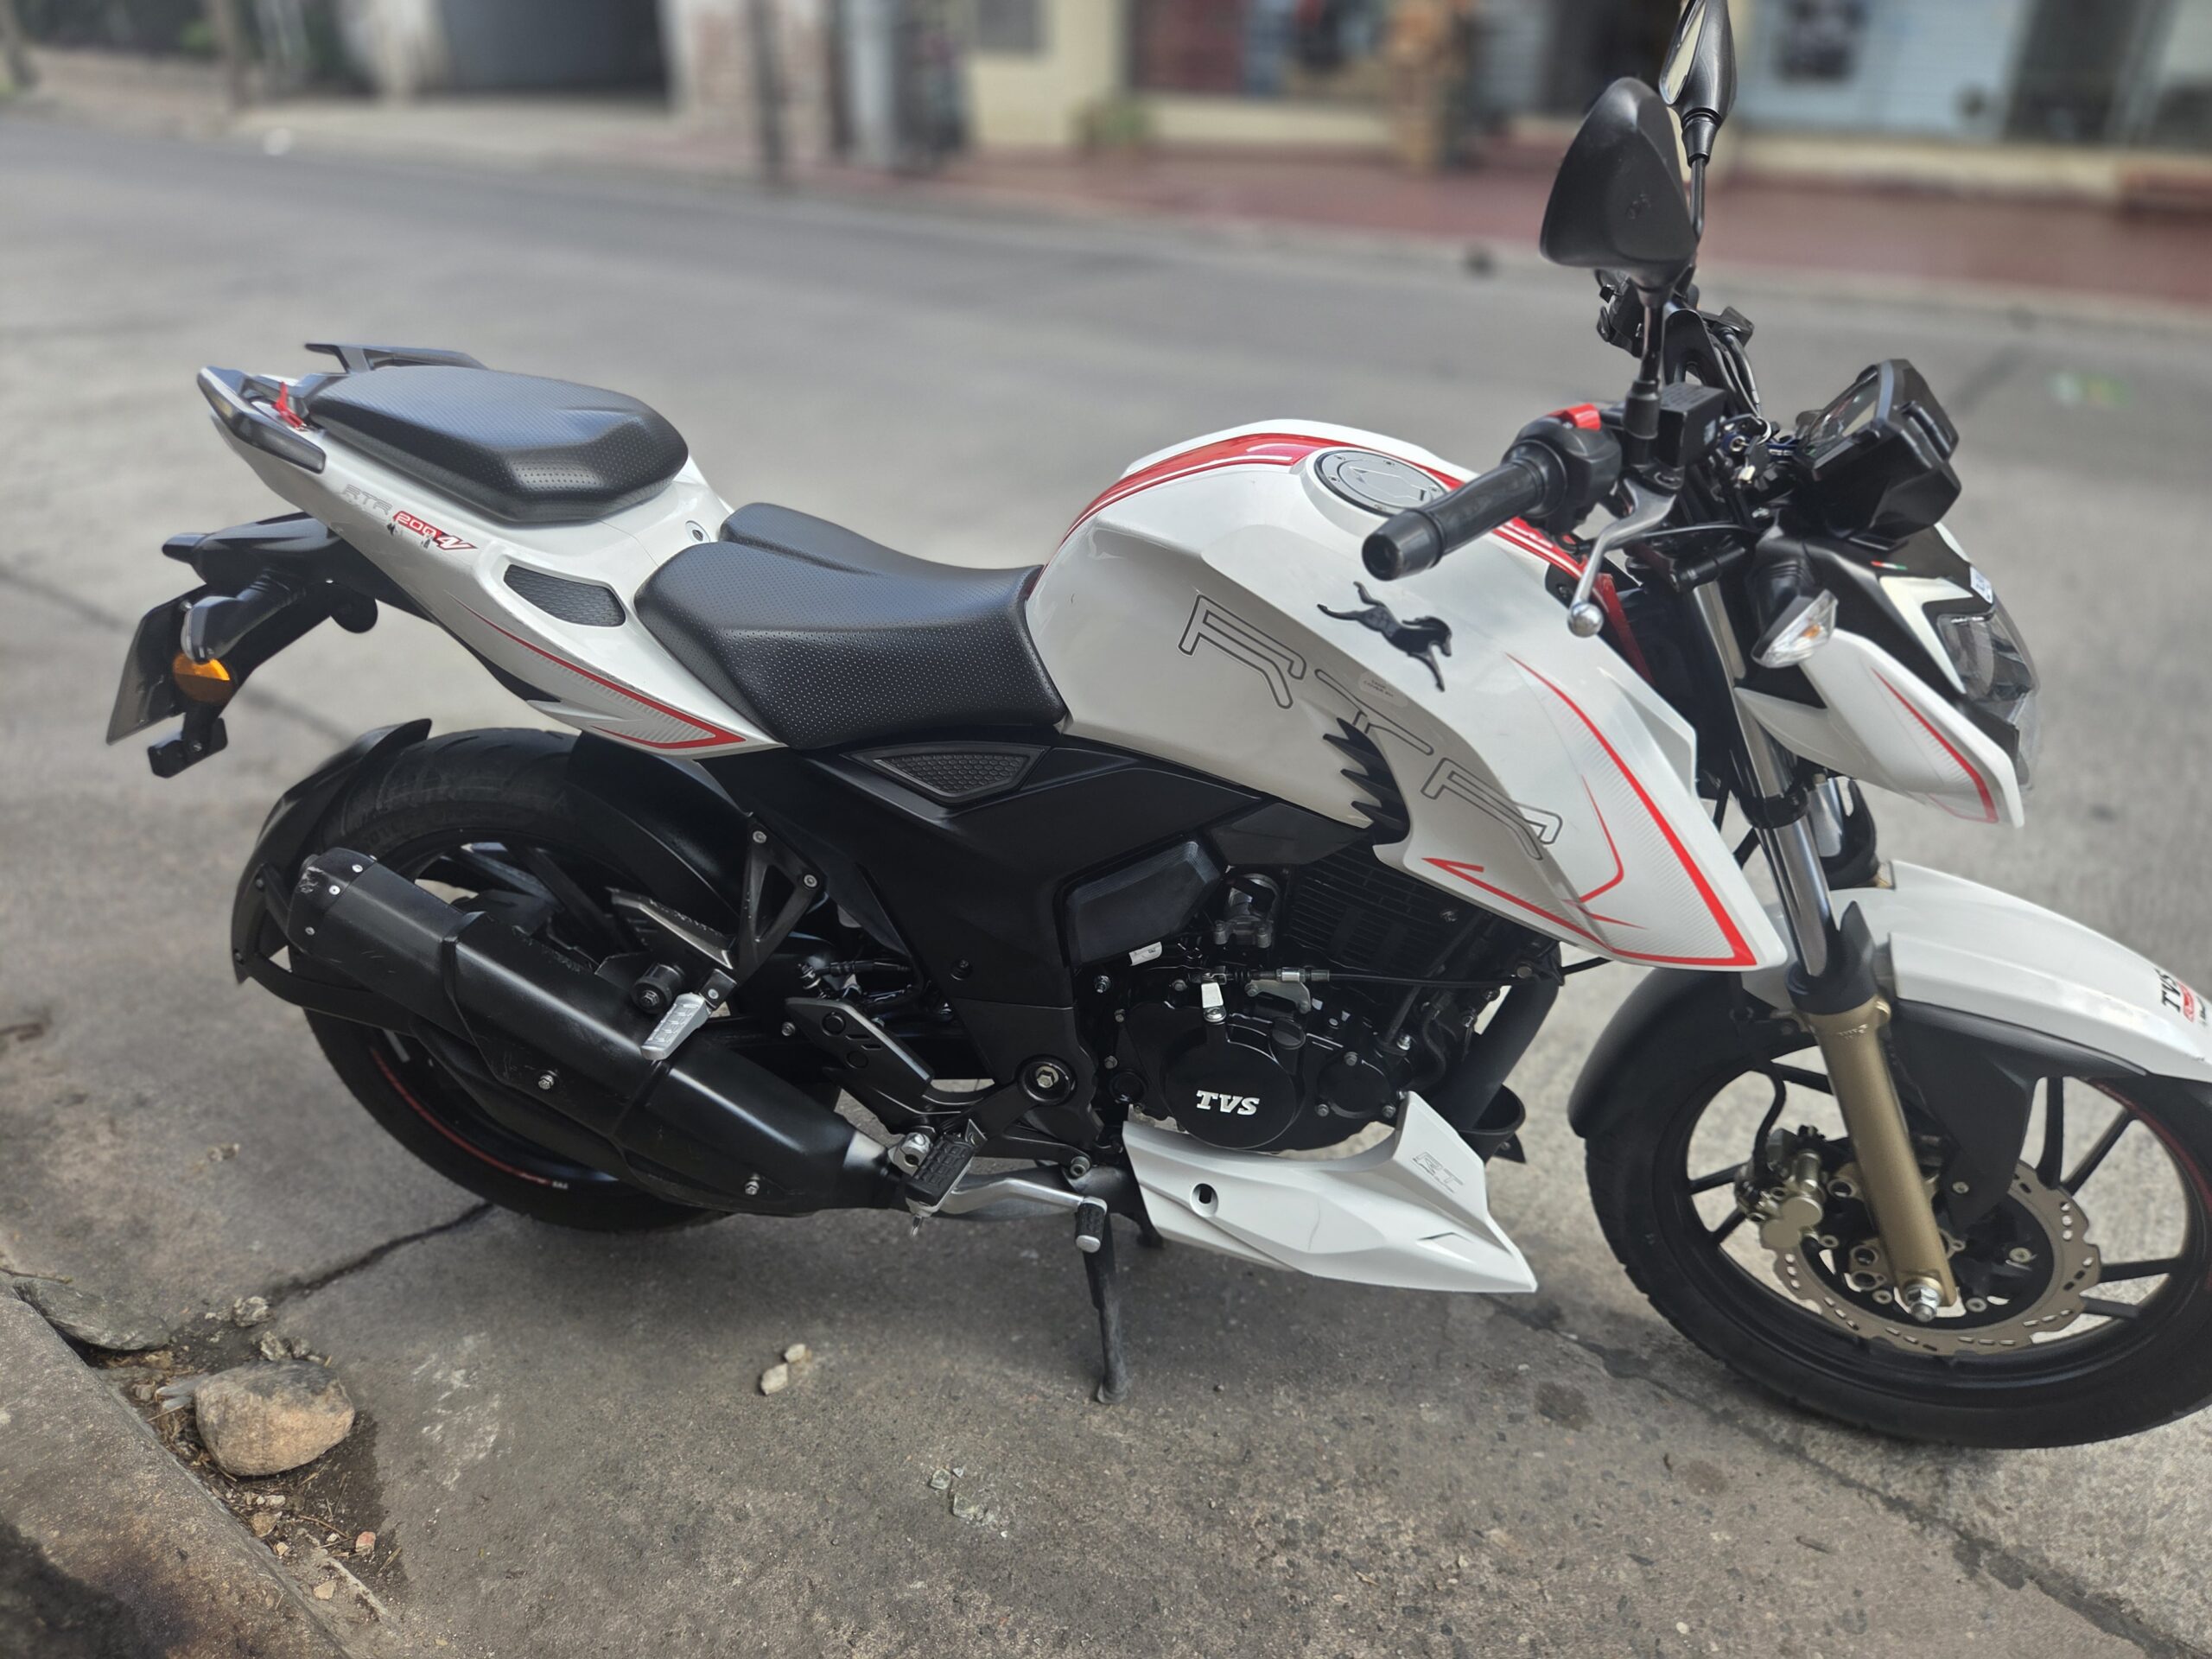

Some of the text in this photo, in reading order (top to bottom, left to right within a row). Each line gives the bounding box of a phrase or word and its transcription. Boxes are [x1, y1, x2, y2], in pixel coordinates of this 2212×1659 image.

[343, 483, 393, 516] RTR
[1178, 594, 1563, 861] RTR
[2154, 968, 2181, 1013] TVS
[1196, 1090, 1261, 1116] TVS
